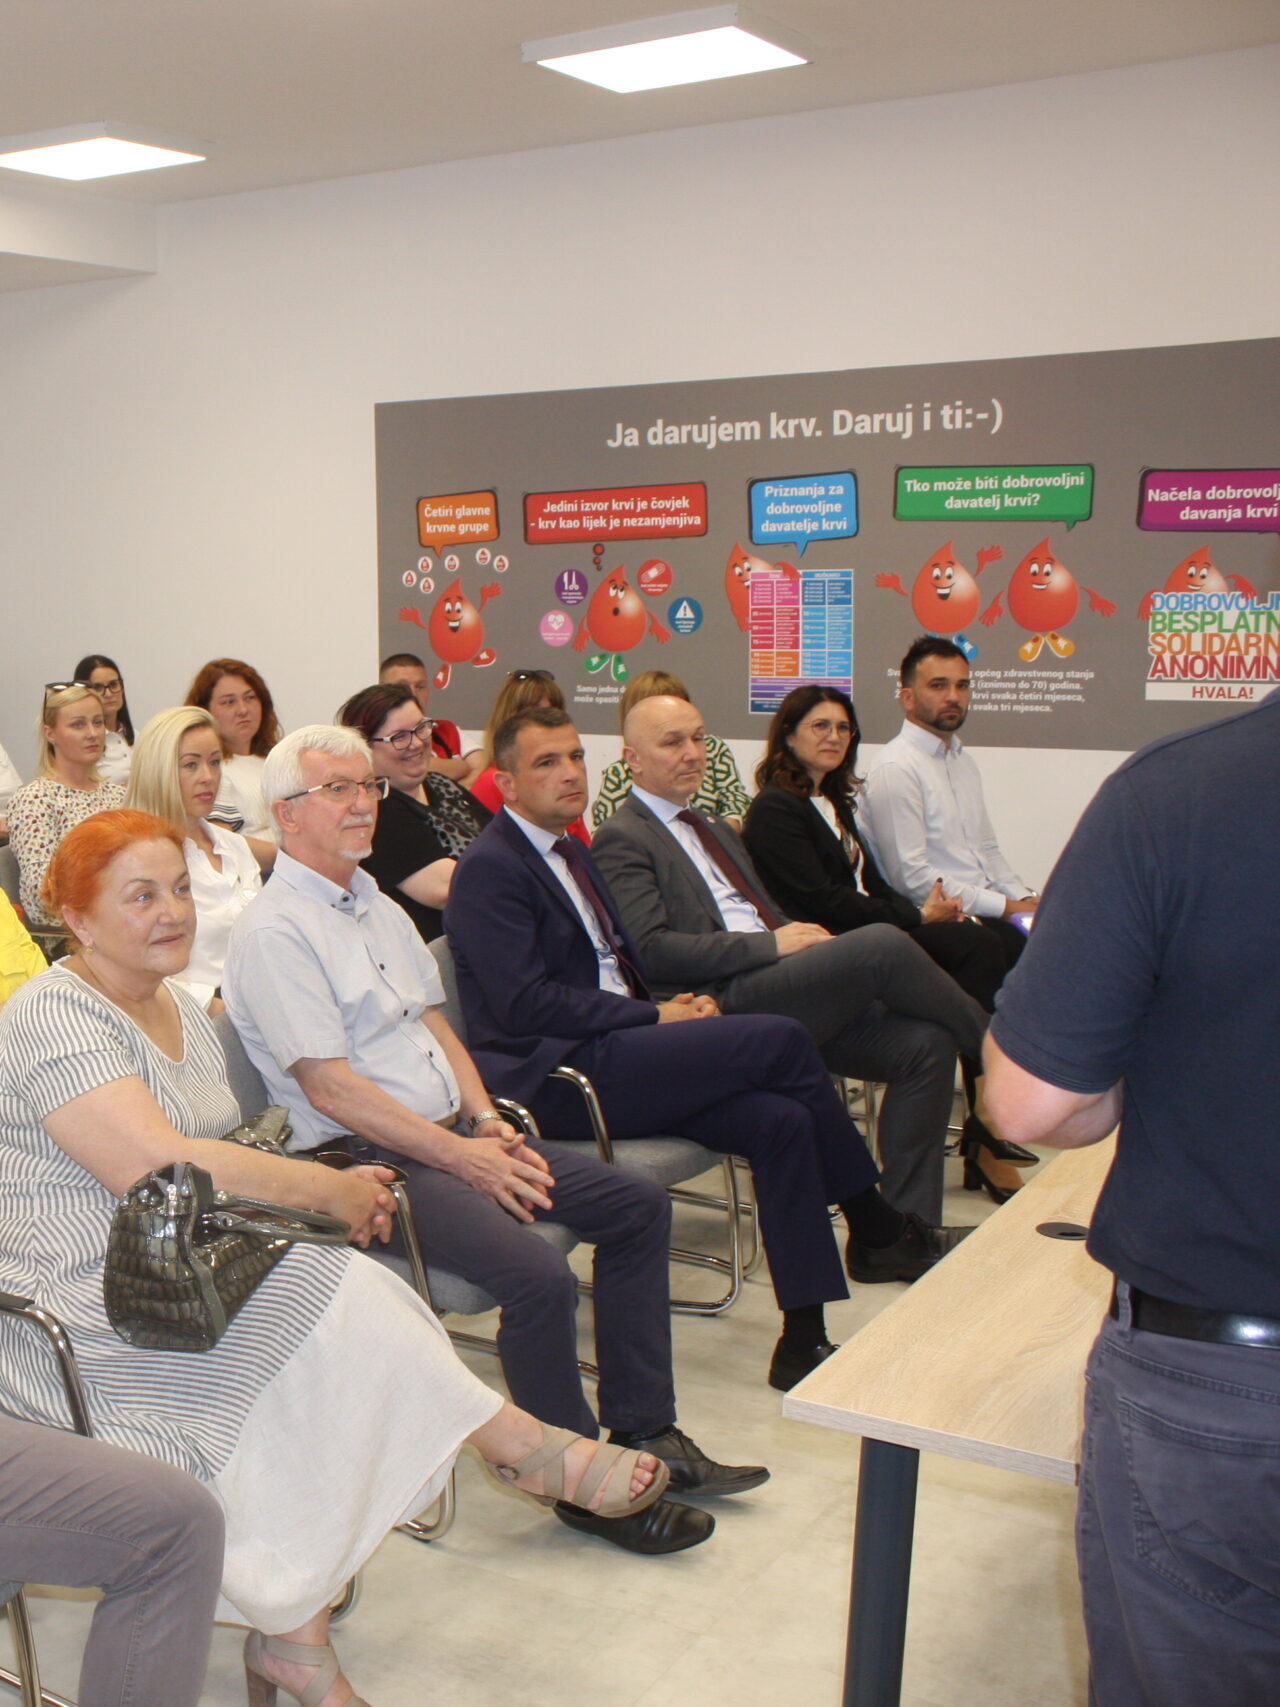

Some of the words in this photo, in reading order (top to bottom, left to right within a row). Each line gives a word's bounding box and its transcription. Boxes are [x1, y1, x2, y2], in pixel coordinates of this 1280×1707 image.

[606, 423, 639, 448] Ja
[646, 415, 761, 450] darujem
[769, 412, 822, 440] krv.
[832, 403, 913, 439] Daruj
[923, 402, 931, 431] i
[940, 398, 1004, 435] ti:-)
[904, 479, 930, 492] Tko
[934, 477, 972, 491] može
[975, 476, 998, 490] biti
[1002, 472, 1085, 489] dobrovoljni
[764, 483, 825, 499] Priznanja
[828, 485, 844, 495] za
[1148, 487, 1202, 502] Načela
[543, 500, 578, 513] Jedini
[581, 500, 609, 512] izvor
[612, 498, 634, 510] krvi
[636, 498, 648, 513] je
[651, 496, 690, 511] čovjek
[766, 500, 842, 516] dobrovoljne
[945, 494, 1000, 510] davatelj
[1004, 493, 1040, 507] krvi?
[424, 504, 453, 518] Četiri
[455, 505, 491, 519] glavne
[1180, 506, 1242, 522] davanja
[1246, 503, 1278, 518] krvi
[426, 522, 456, 533] krvne
[458, 522, 489, 535] grupe
[538, 517, 557, 529] krv
[559, 517, 580, 528] kao
[583, 515, 607, 531] lijek
[609, 515, 621, 530] je
[623, 513, 701, 529] nezamjenjiva
[761, 518, 819, 534] davatelje
[822, 517, 848, 530] krvi
[974, 669, 1001, 679] općeg
[1003, 669, 1064, 680] zdravstvenog
[1066, 669, 1095, 680] stanja
[1018, 680, 1030, 689] do
[1192, 686, 1254, 699] HVALA!
[972, 691, 989, 700] krvi
[991, 691, 1017, 700] svaka
[973, 702, 998, 711] svaka
[1000, 702, 1011, 711] tri
